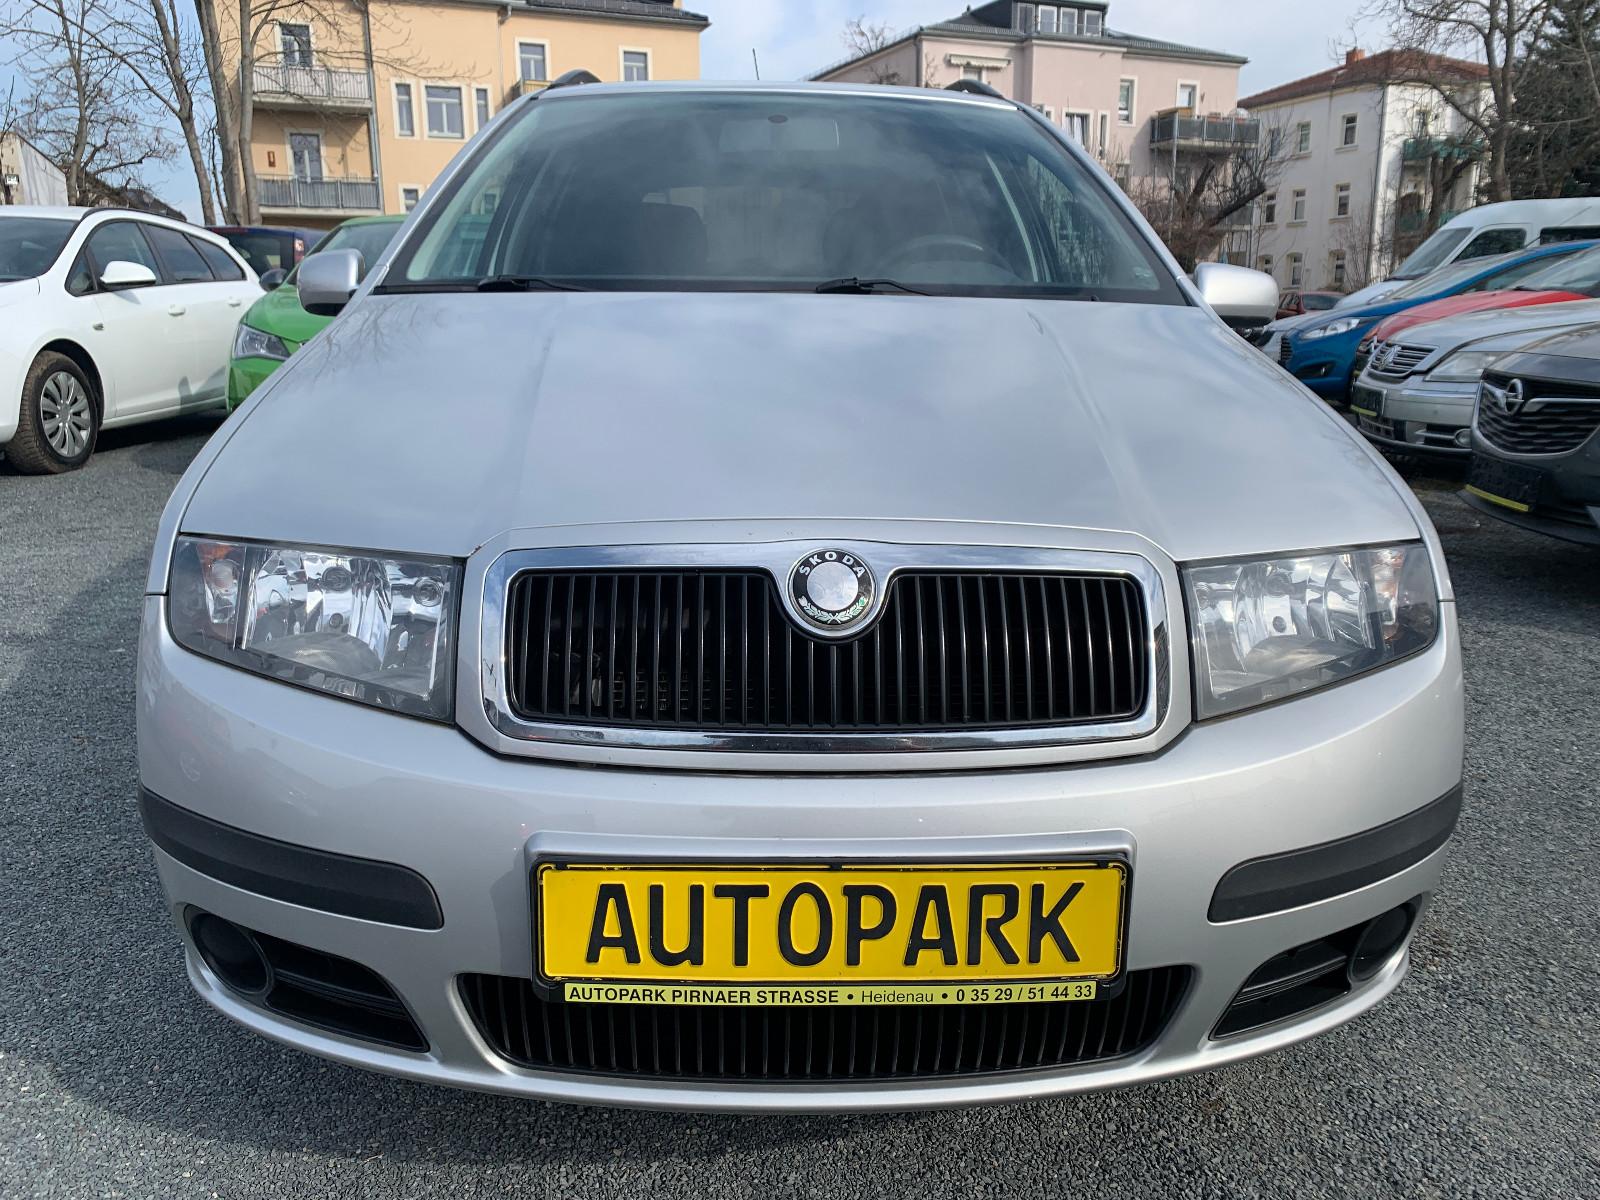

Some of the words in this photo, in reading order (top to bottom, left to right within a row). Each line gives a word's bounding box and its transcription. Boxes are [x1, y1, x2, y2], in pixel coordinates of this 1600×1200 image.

[585, 881, 1085, 966] AUTOPARK
[568, 986, 666, 1001] AUTOPARK
[671, 990, 751, 1003] PIRNAER
[756, 990, 839, 1003] STRASSE
[861, 990, 934, 1003] Heidenau
[956, 988, 965, 1001] 0
[970, 988, 989, 1001] 35
[994, 988, 1012, 1001] 29
[1027, 987, 1045, 1000] 51
[1050, 986, 1069, 1000] 44
[1074, 984, 1092, 998] 33
